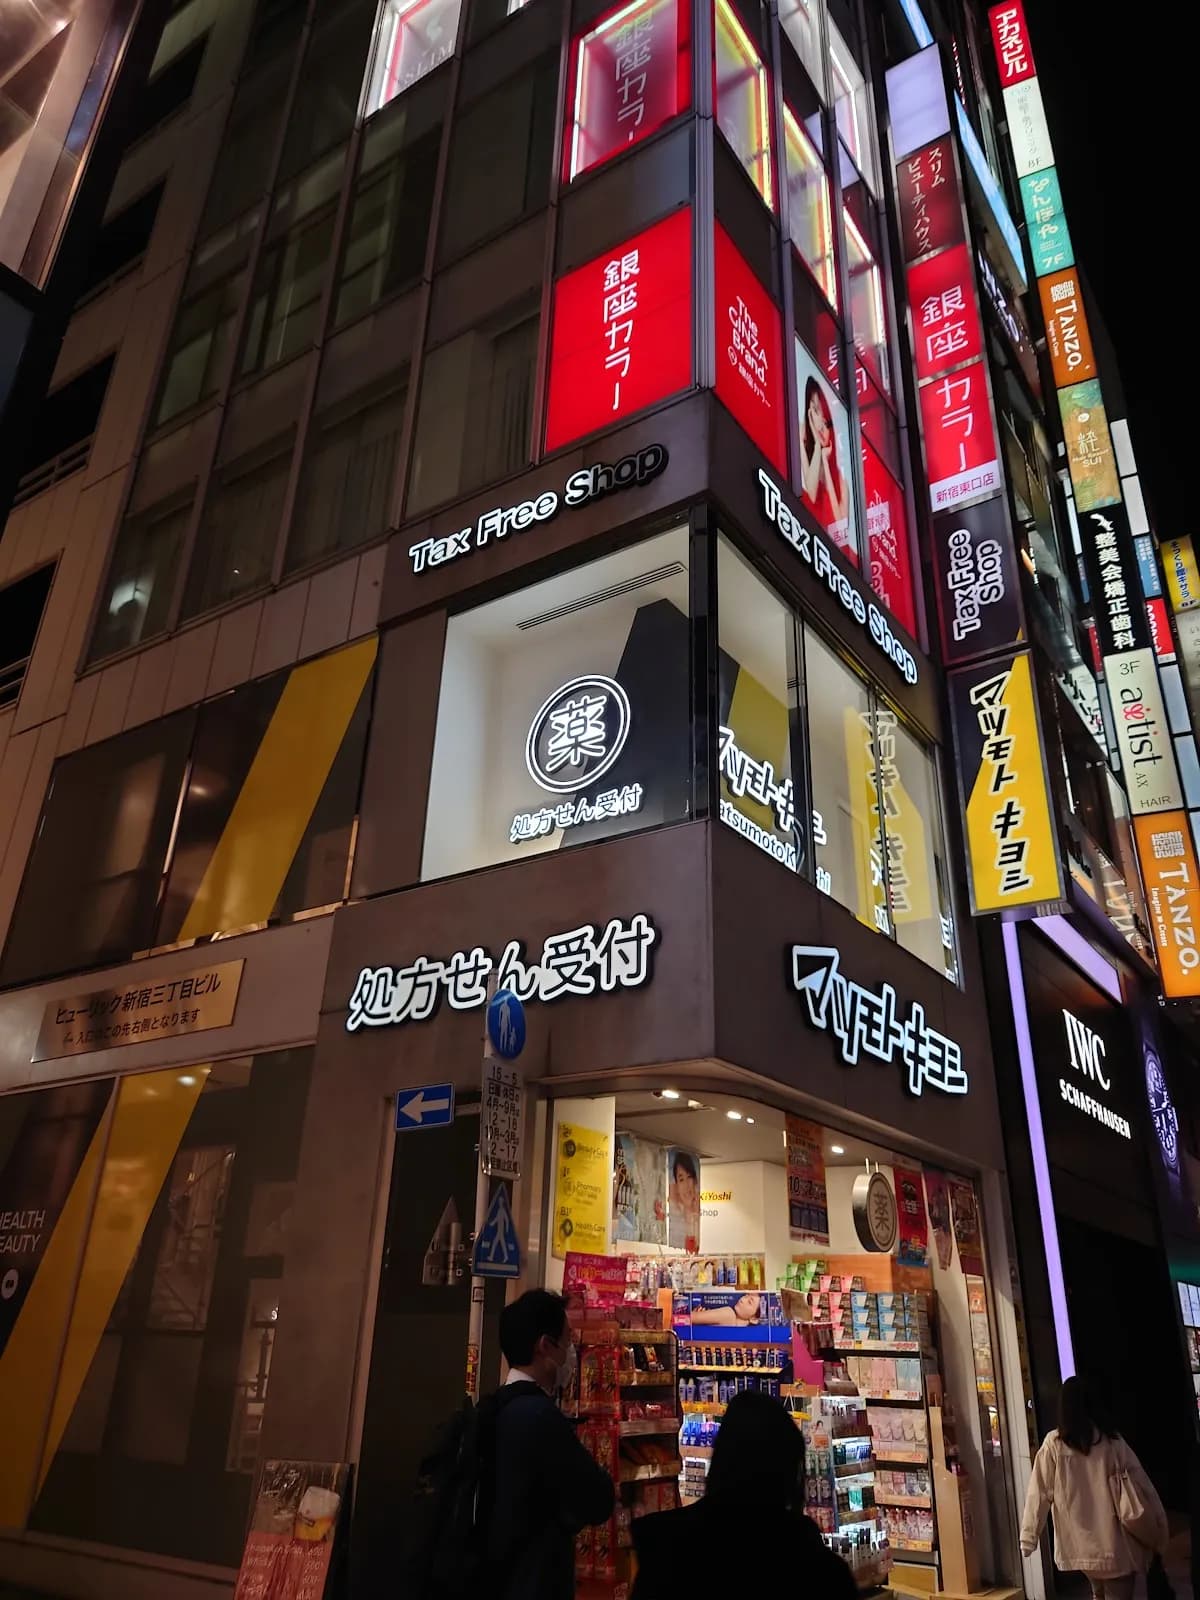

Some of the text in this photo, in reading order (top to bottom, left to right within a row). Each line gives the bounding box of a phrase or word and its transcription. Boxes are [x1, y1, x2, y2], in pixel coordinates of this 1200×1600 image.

[996, 8, 1028, 78] アカネビル
[929, 146, 946, 187] スリム
[908, 156, 932, 252] ビューティハウス
[1028, 177, 1058, 239] なんぼや
[603, 248, 640, 410] 銀座カラー
[728, 306, 768, 370] GINZA
[736, 295, 758, 337] The
[733, 327, 767, 387] Brand.
[409, 443, 669, 573] Tax Free Shop
[935, 472, 995, 505] 新宿東口店
[758, 468, 812, 564] Tax
[813, 535, 866, 625] Free
[868, 603, 918, 685] Shop
[948, 528, 981, 641] Tax Free
[976, 539, 1005, 606] Shop
[1094, 531, 1136, 650] 整美会矯正歯科
[1119, 660, 1141, 676] 3F
[546, 696, 608, 773] 薬
[509, 782, 642, 843] 処方せん受付
[969, 670, 1031, 894] マツモトキヨシ
[1140, 795, 1172, 808] HAIR
[345, 914, 656, 1032] 処方せん受付
[792, 944, 968, 1096] マツモトキヨシ
[1062, 1008, 1110, 1091] IWC
[1060, 1078, 1131, 1140] SCHAFFHAUSEN
